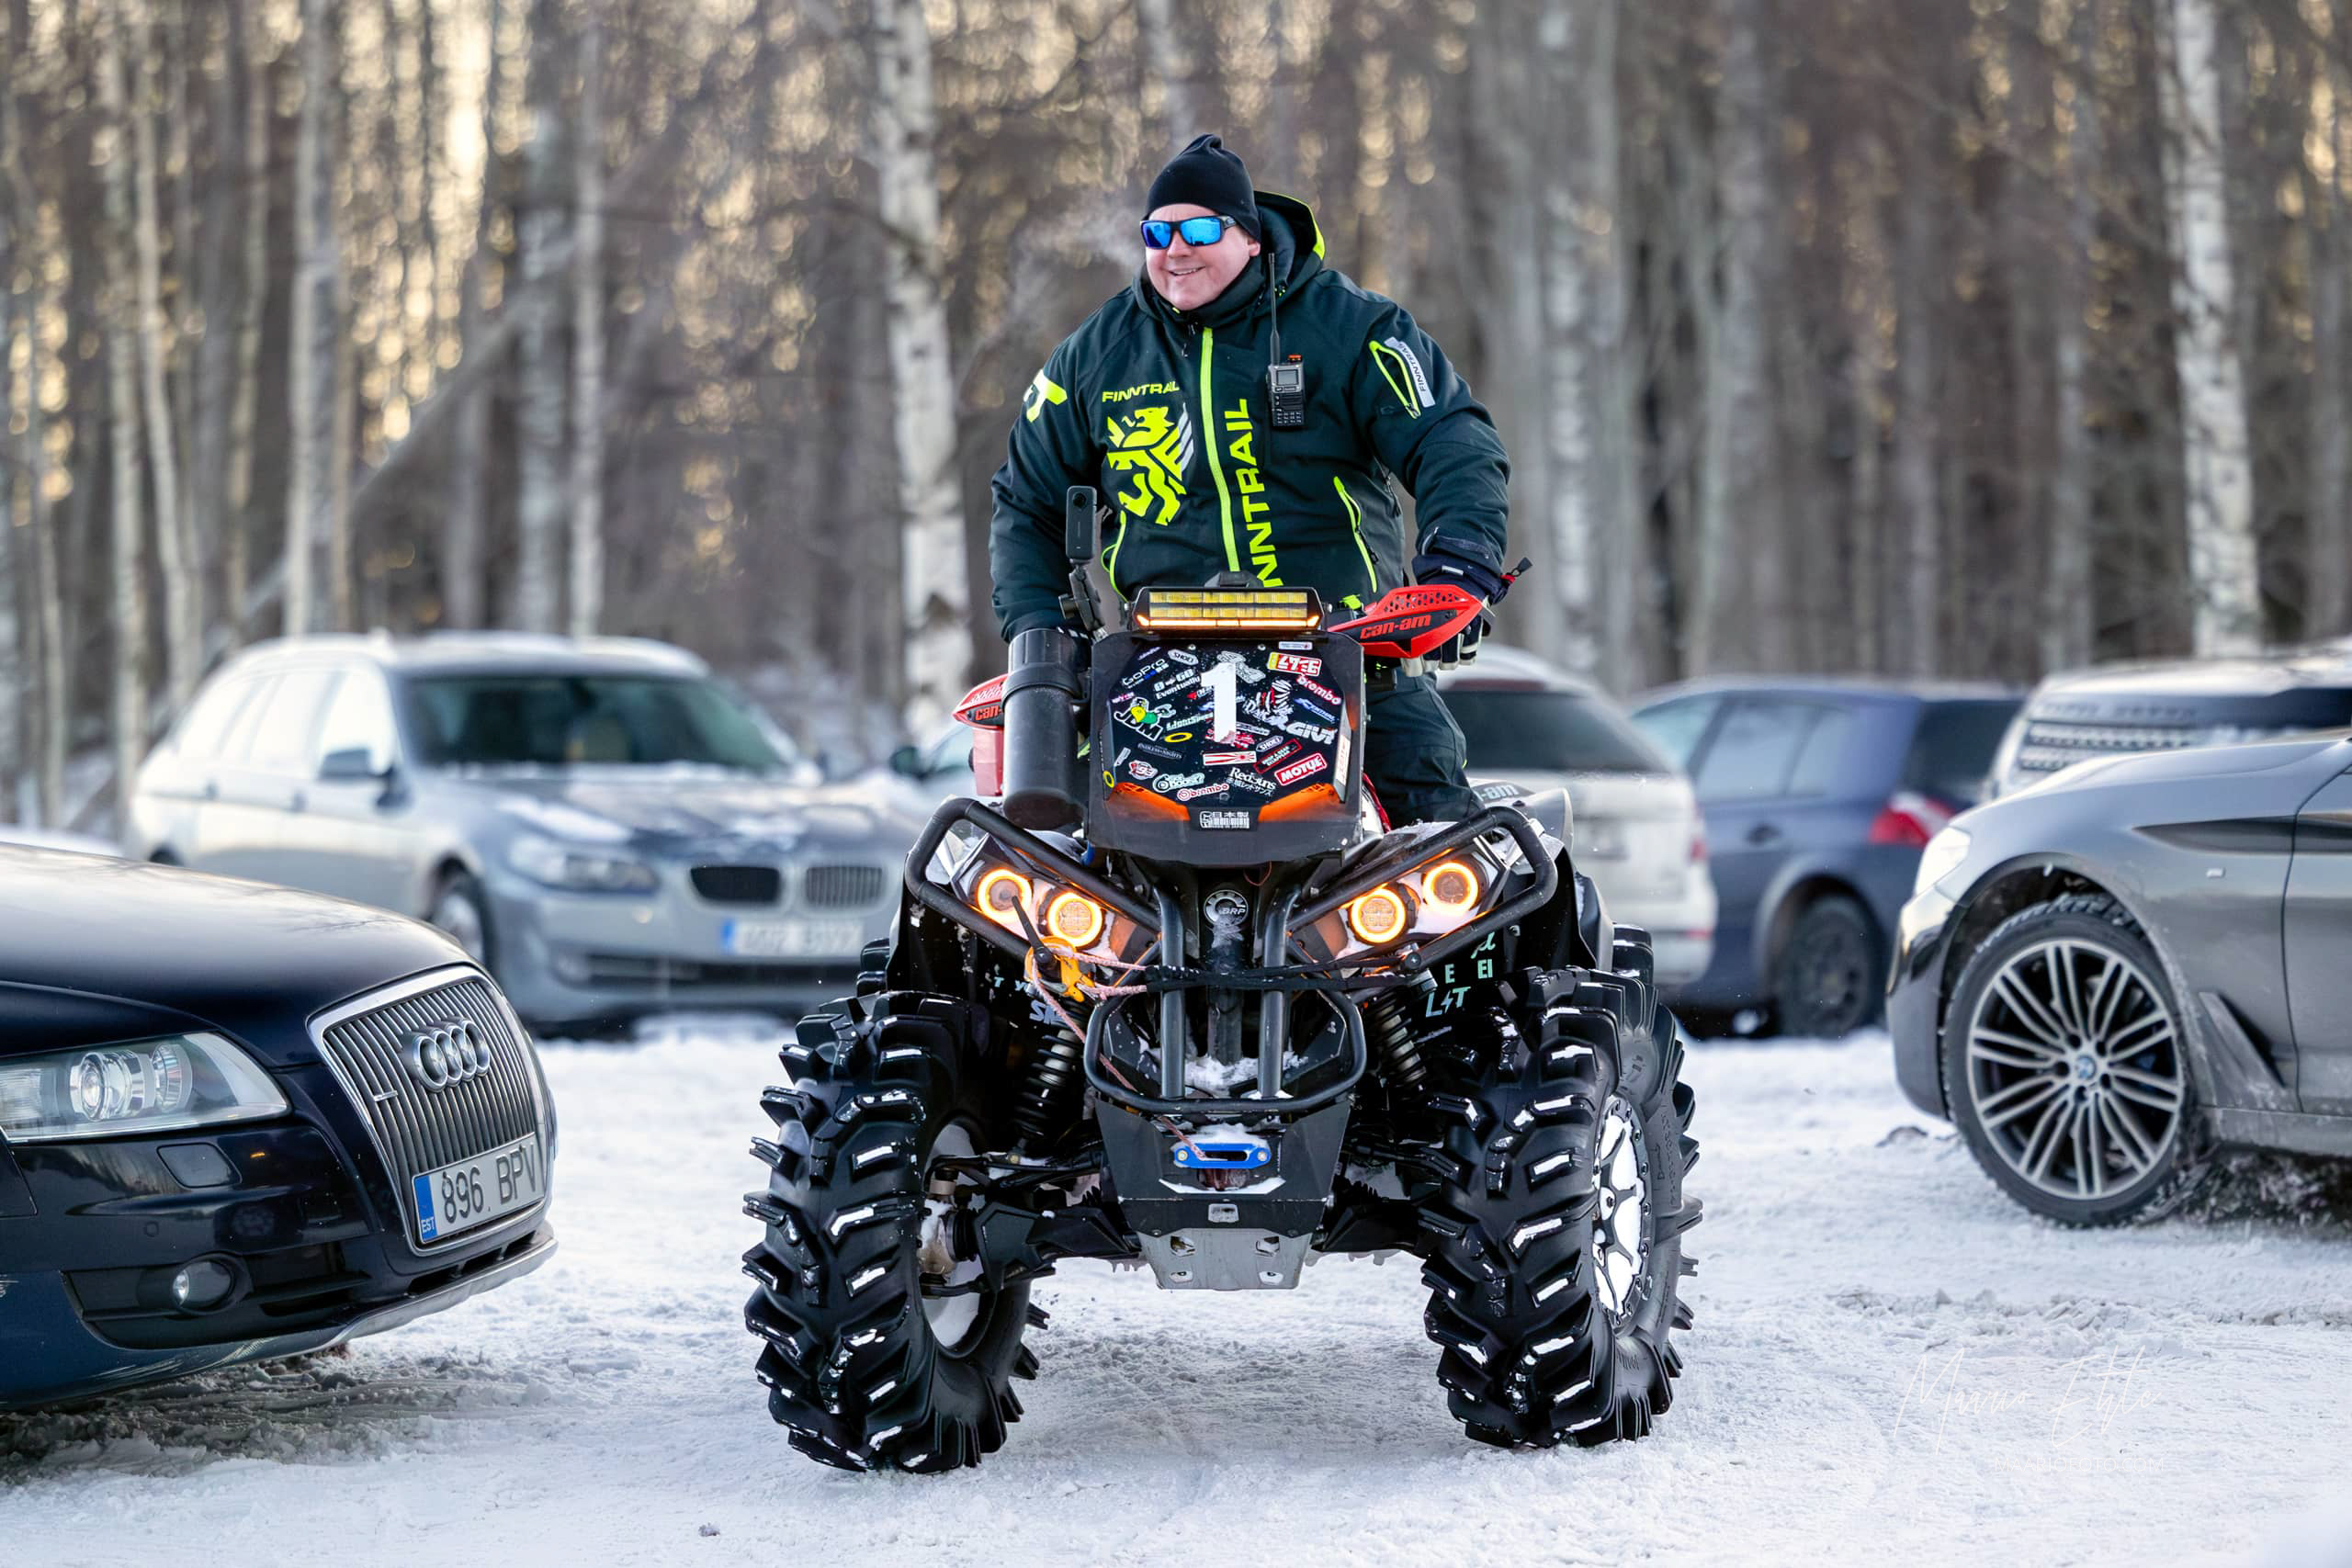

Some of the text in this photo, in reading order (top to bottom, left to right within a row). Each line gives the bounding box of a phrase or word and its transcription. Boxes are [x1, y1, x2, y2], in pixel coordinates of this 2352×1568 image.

[1225, 399, 1284, 588] NNTRAIL
[1360, 615, 1432, 640] can-am
[1122, 658, 1166, 686] GoPro
[1156, 675, 1201, 700] Eventually
[1296, 675, 1342, 705] brembo
[975, 705, 1002, 721] can-
[1201, 661, 1237, 744] 1
[1190, 783, 1230, 798] brembo
[1220, 906, 1247, 916] BRP
[441, 1144, 537, 1224] 896 BPV
[421, 1217, 435, 1234] EST
